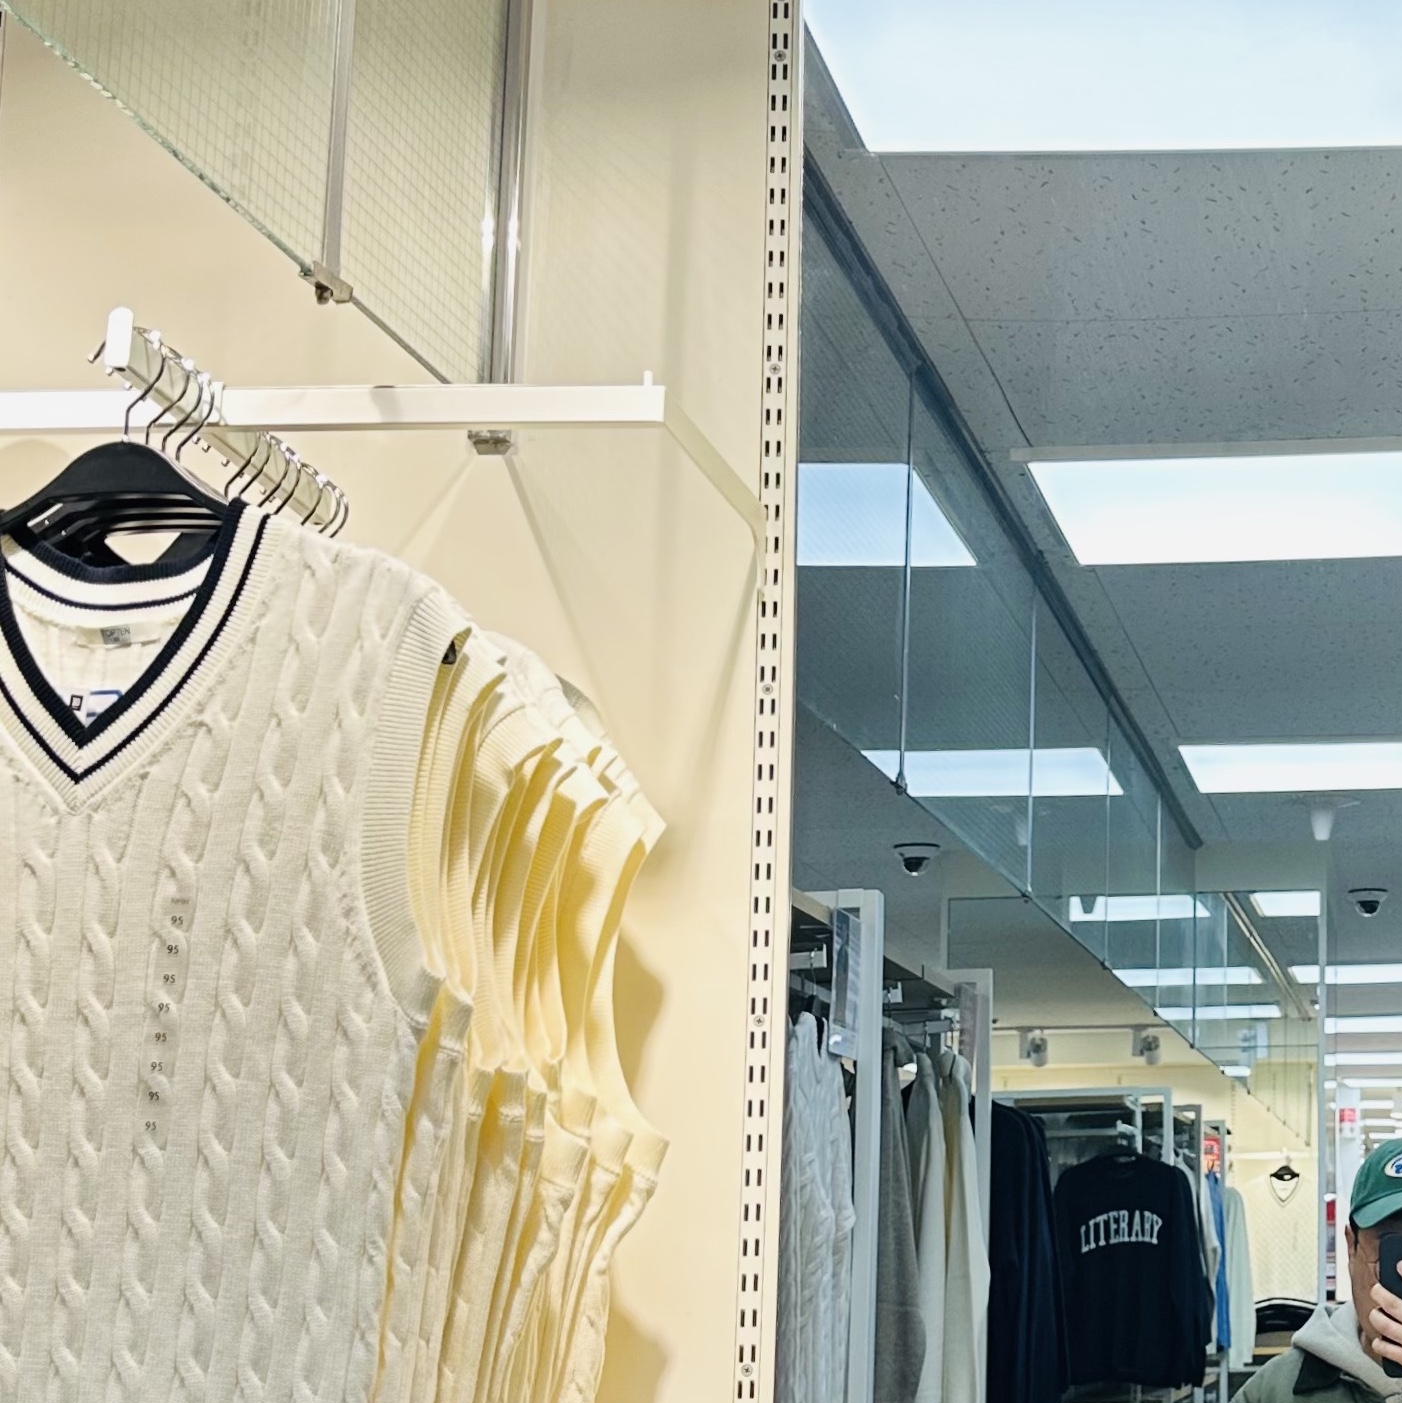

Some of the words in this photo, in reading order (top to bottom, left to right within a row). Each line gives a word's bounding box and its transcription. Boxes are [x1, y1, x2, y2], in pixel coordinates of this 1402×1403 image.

[171, 915, 183, 926] 95
[167, 944, 179, 955] 95
[163, 973, 176, 984] 95
[158, 1003, 171, 1012] 95
[155, 1032, 167, 1042] 95
[150, 1061, 163, 1072] 95
[148, 1091, 160, 1101] 95
[145, 1121, 157, 1131] 95
[1080, 1209, 1163, 1254] LITERARY
